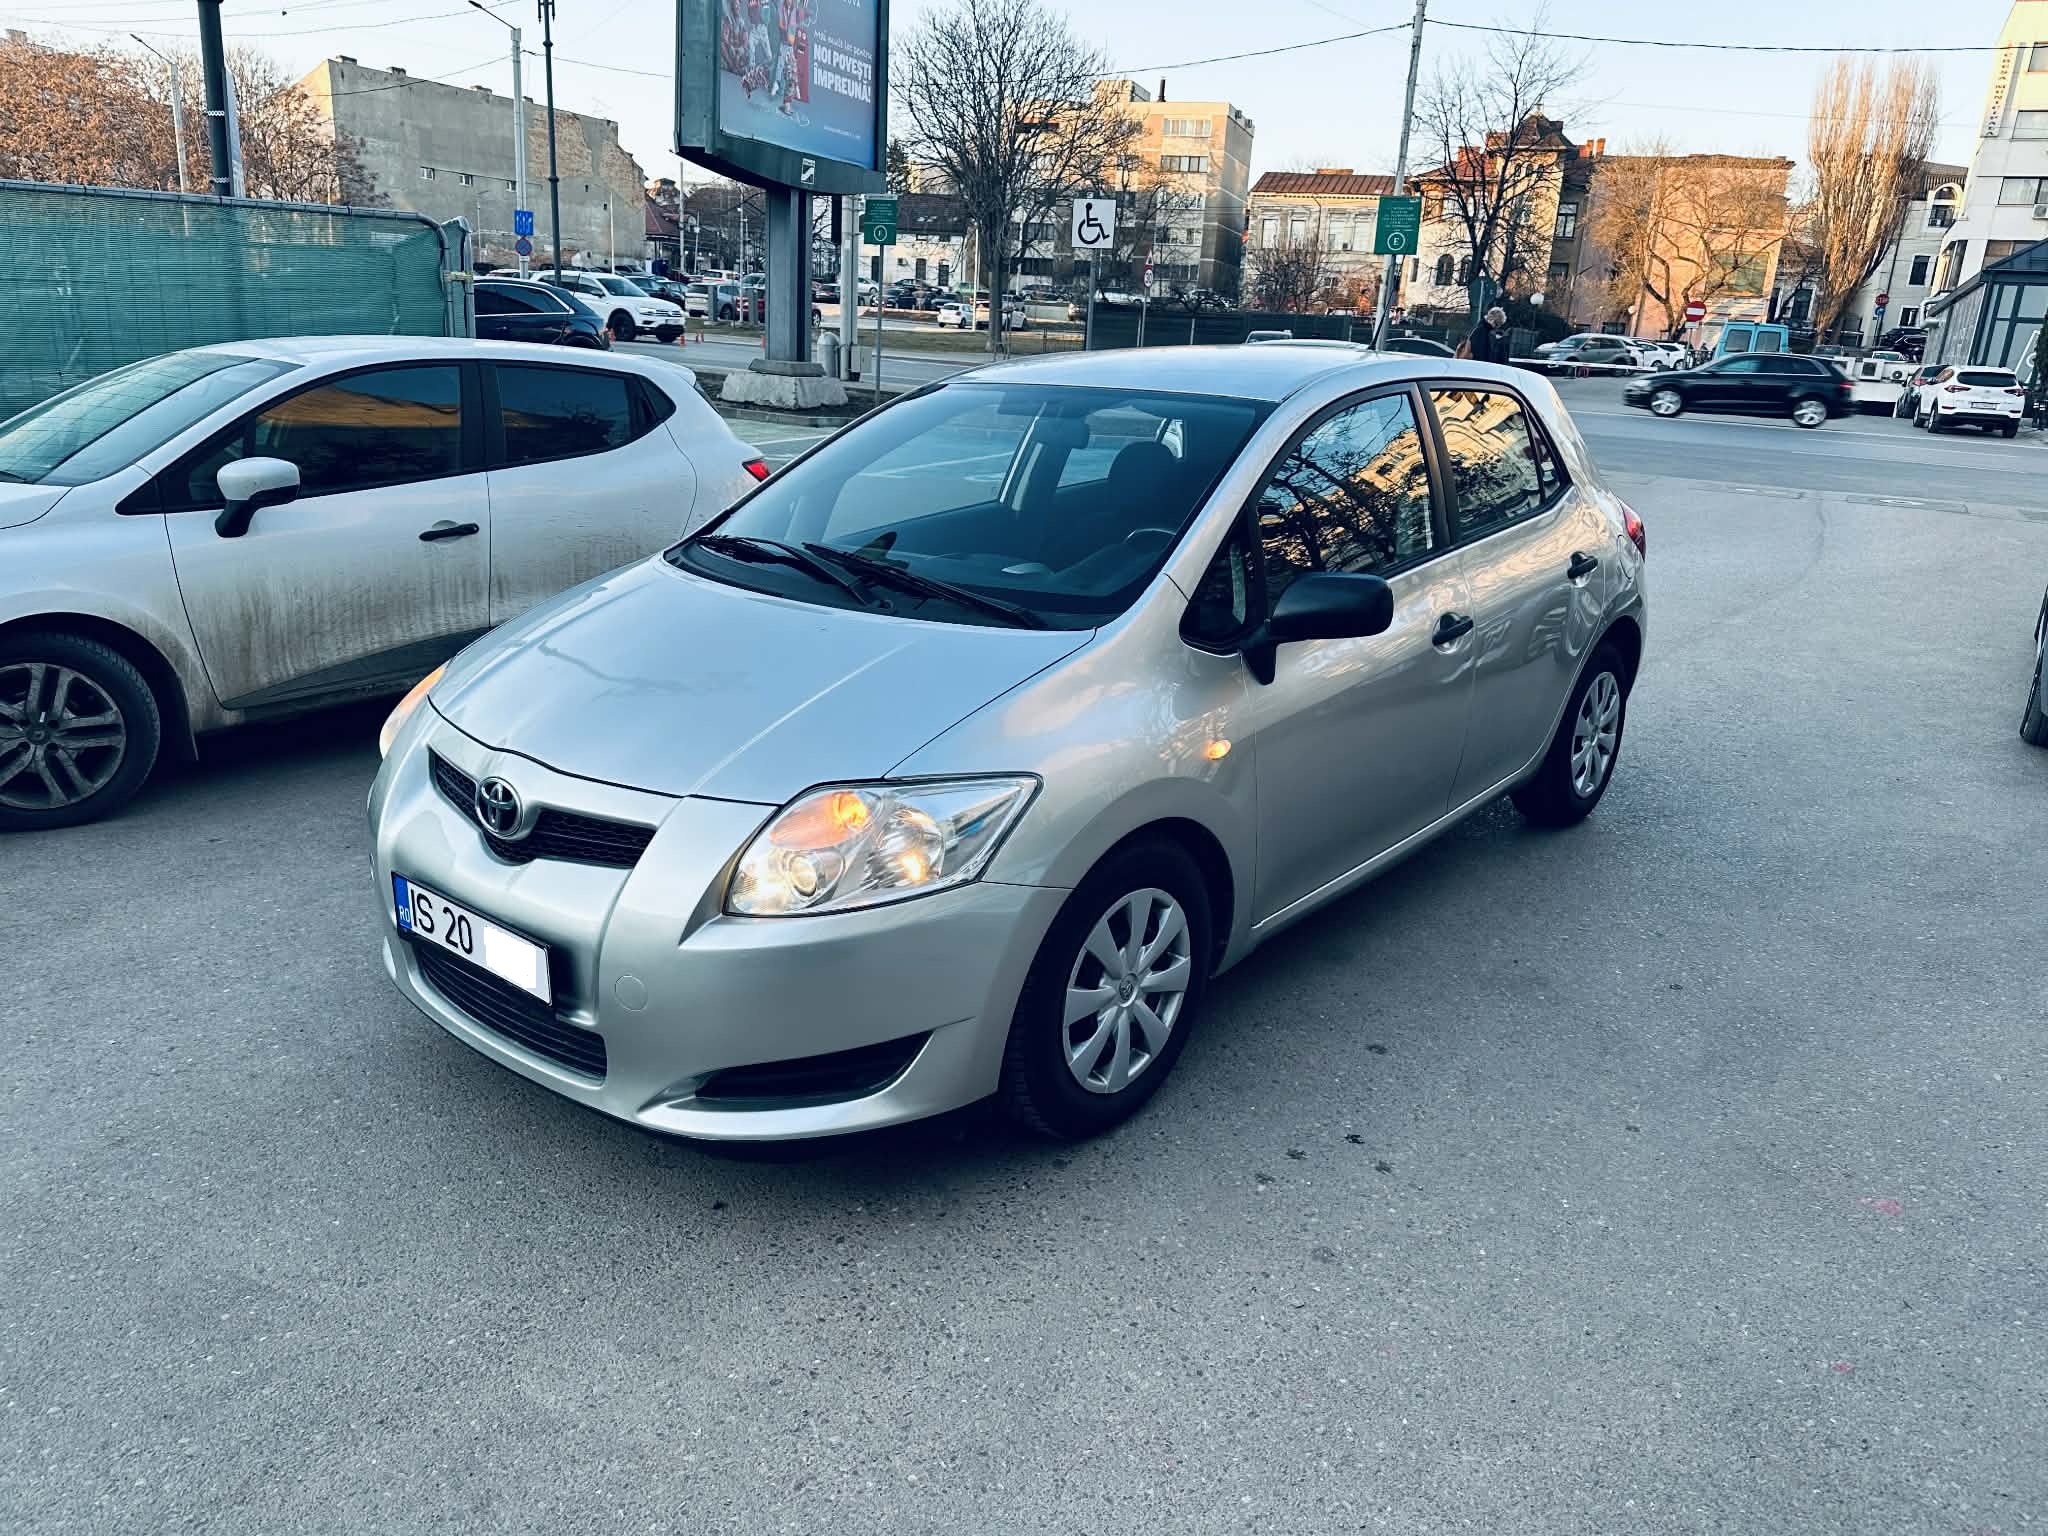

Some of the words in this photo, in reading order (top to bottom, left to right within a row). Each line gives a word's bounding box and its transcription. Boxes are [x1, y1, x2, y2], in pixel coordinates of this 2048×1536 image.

[814, 43, 831, 65] NOI
[832, 51, 872, 81] POVEȘTI
[813, 62, 871, 104] ÎMPREUNĂ!
[399, 906, 410, 923] RO
[411, 889, 434, 933] IS
[443, 907, 473, 954] 20
